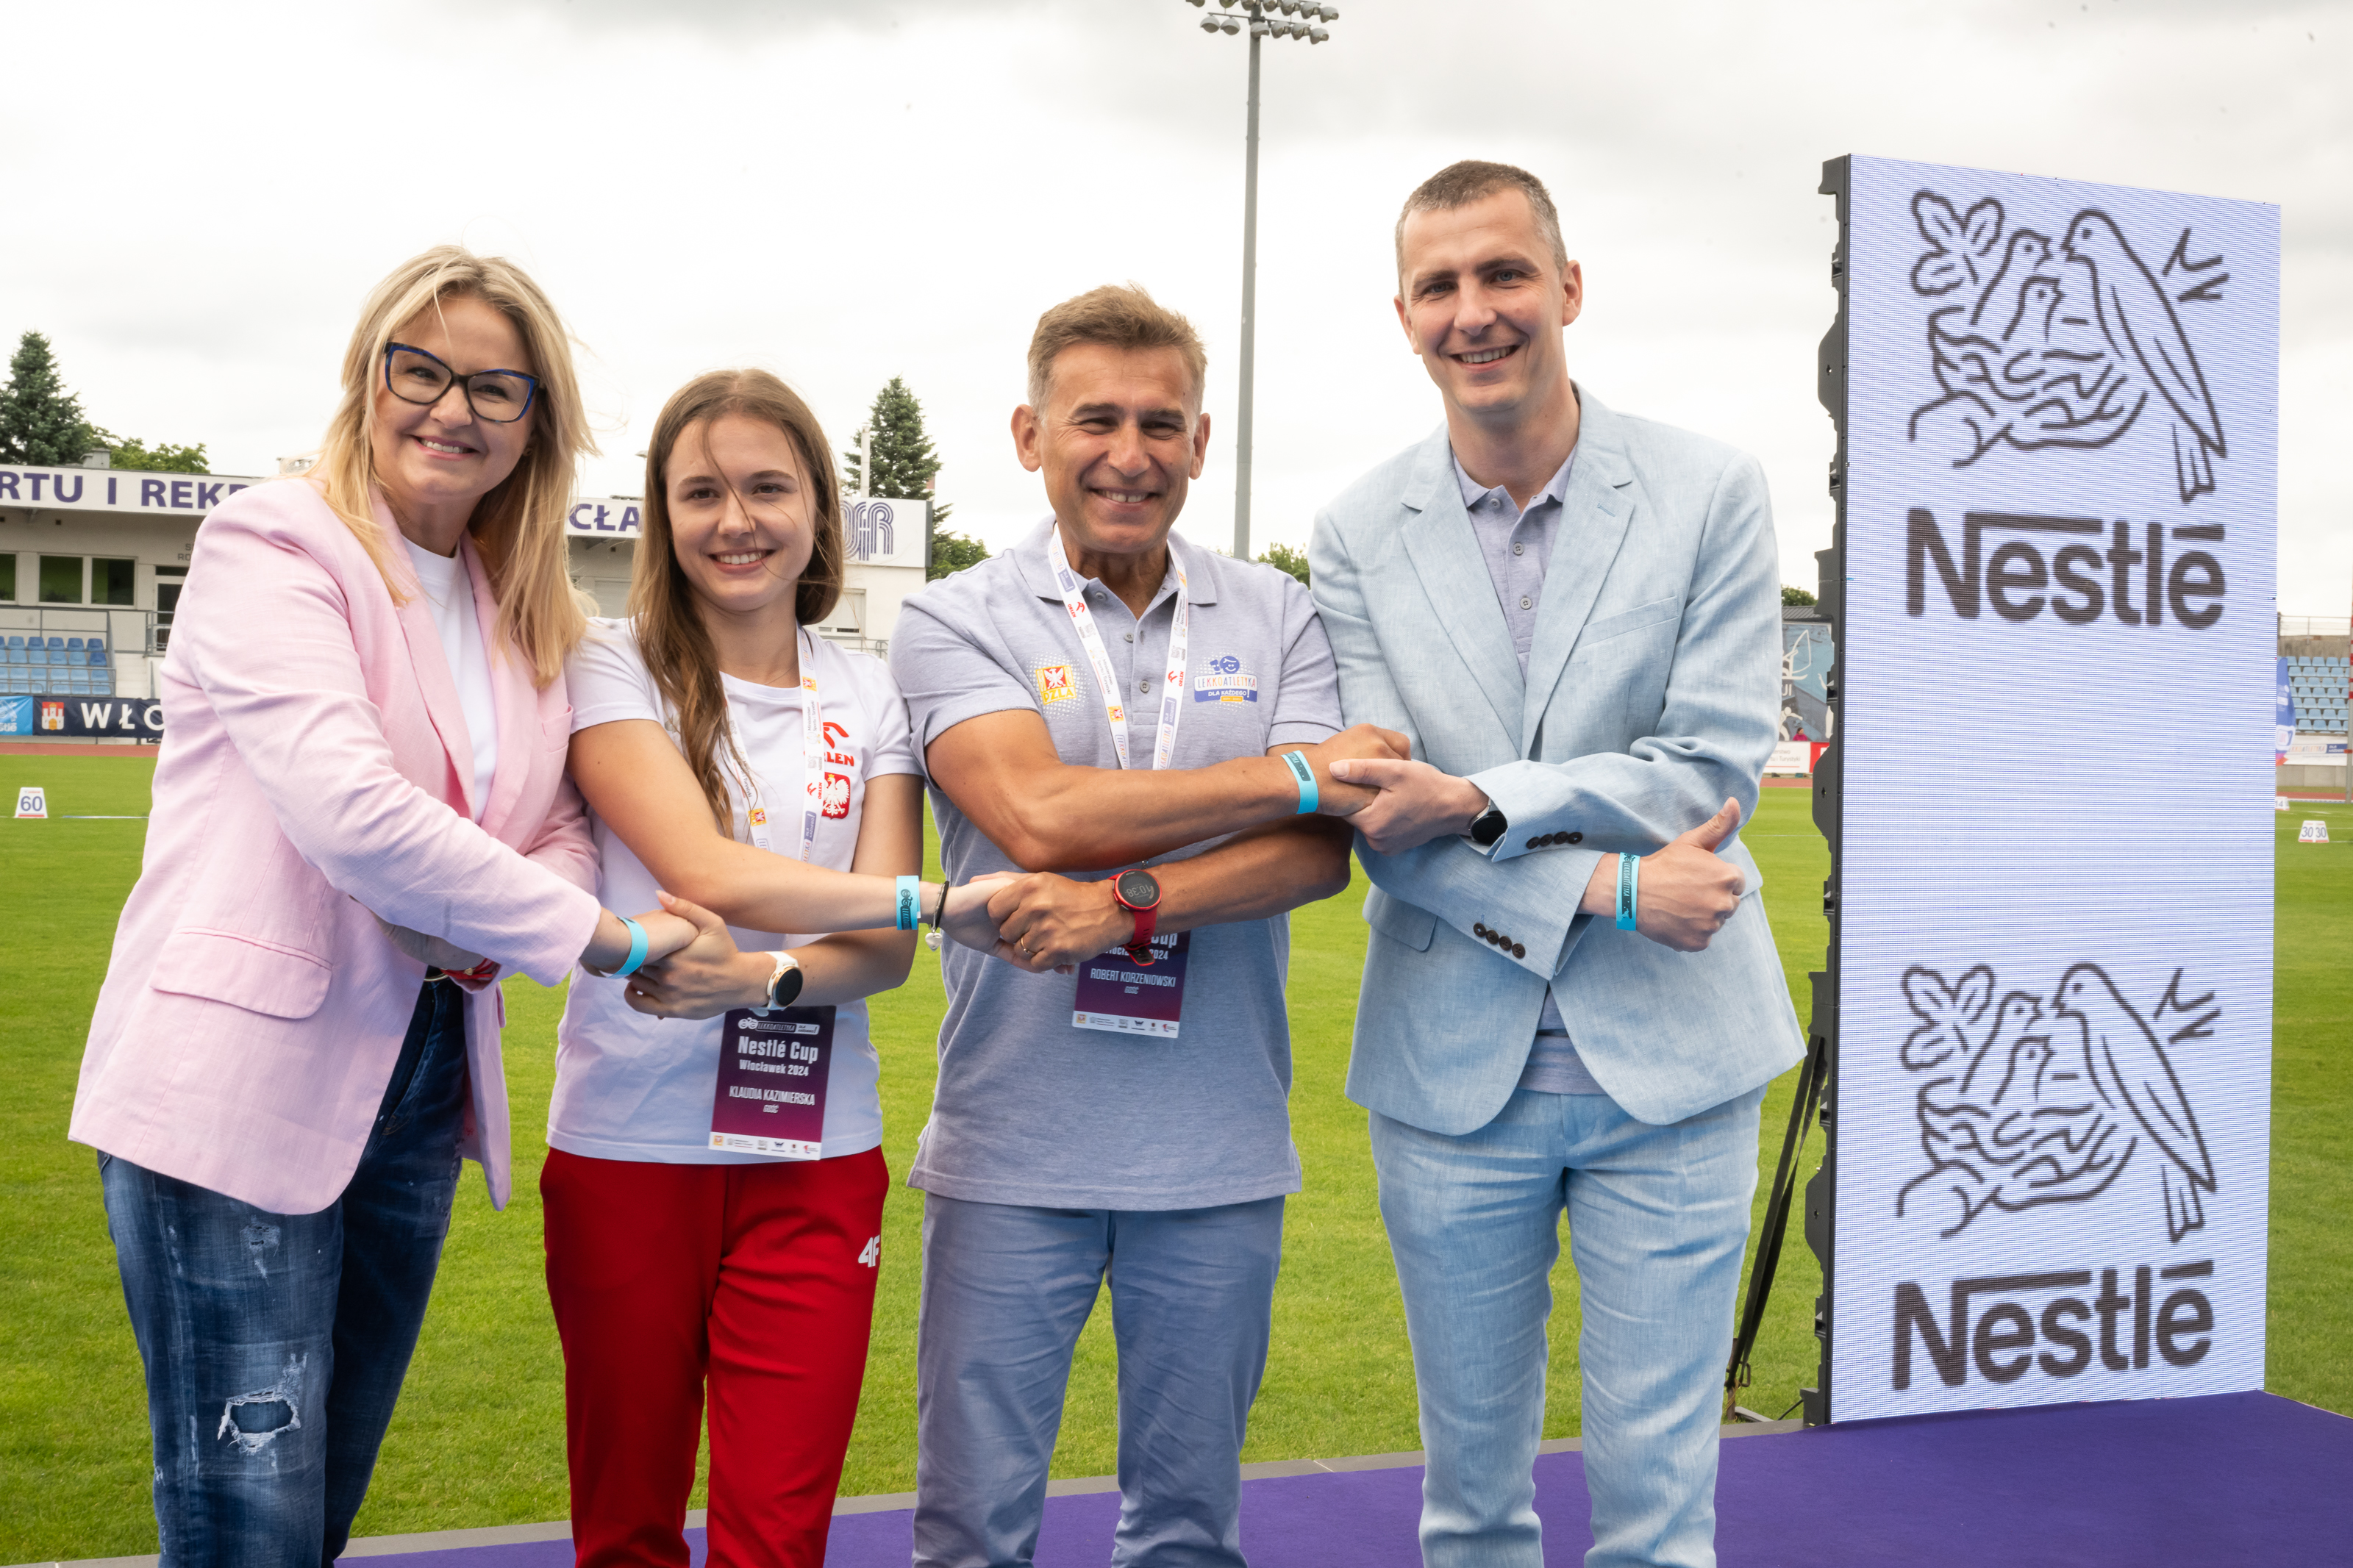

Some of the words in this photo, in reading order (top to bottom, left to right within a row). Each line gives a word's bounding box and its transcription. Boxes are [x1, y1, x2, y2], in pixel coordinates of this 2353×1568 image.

[107, 477, 116, 504] I
[1068, 604, 1076, 618] ORLEN
[1198, 676, 1256, 688] LEKKOATLETYKA
[1043, 688, 1074, 703] PZLA
[824, 751, 854, 767] LEN
[21, 796, 43, 812] 60
[2302, 826, 2313, 837] 30
[2315, 827, 2327, 838] 30
[1090, 968, 1120, 981] ROBERT
[1120, 971, 1176, 987] KORZENIOWSKI
[757, 1023, 795, 1031] LEKKOATLETYKA
[738, 1036, 786, 1058] Nestlé
[790, 1041, 818, 1064] Cup
[739, 1059, 786, 1074] Włocławek
[788, 1064, 809, 1076] 2024
[729, 1086, 762, 1100] KLAUDIA
[763, 1089, 815, 1106] KAZIMIERSKA
[858, 1235, 879, 1267] 4F
